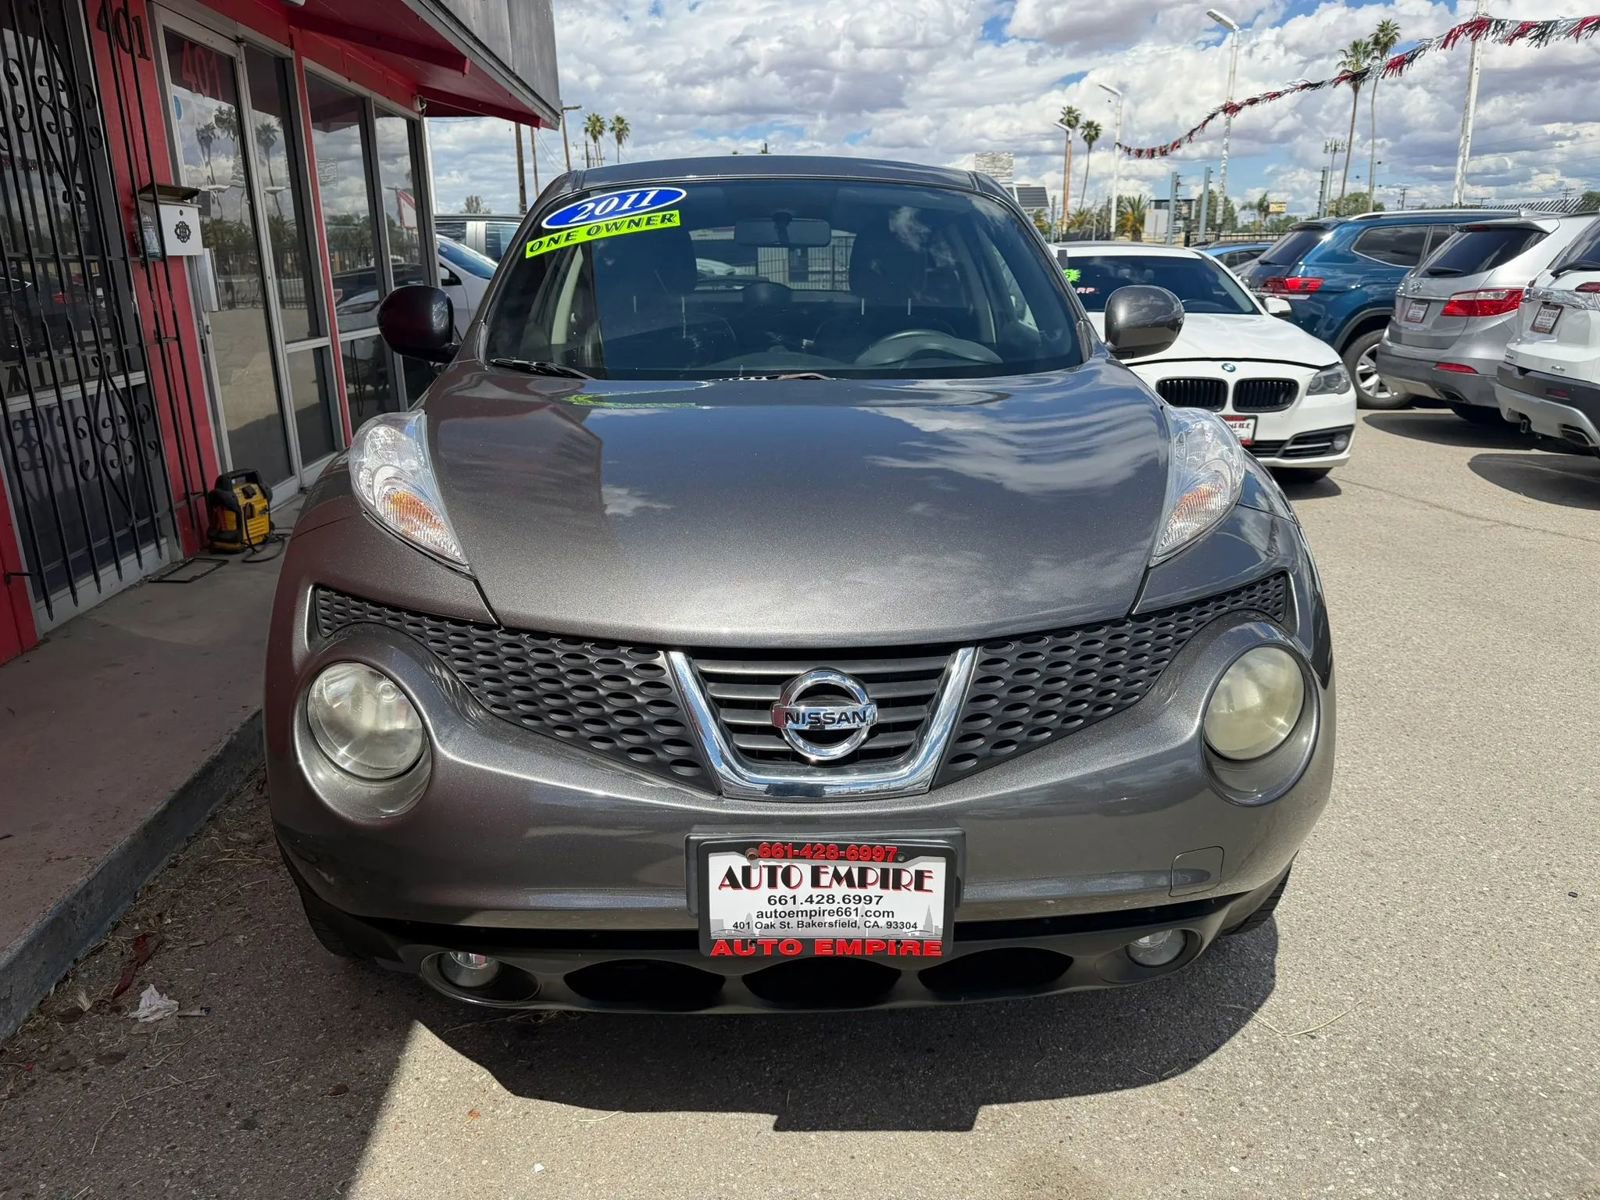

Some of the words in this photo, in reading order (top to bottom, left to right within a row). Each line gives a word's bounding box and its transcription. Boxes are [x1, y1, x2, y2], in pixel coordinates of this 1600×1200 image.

[97, 0, 151, 61] 401
[181, 40, 223, 101] 401
[568, 189, 659, 223] 2011
[528, 230, 578, 253] ONE
[586, 212, 677, 236] OWNER
[784, 709, 867, 725] NISSAN
[758, 841, 898, 863] 661-428-6997
[718, 864, 803, 891] AUTO
[810, 864, 934, 893] EMPIRE
[767, 893, 884, 906] 661.428.6997
[756, 906, 895, 919] autoempire661.com
[732, 921, 751, 930] 401
[754, 920, 776, 930] Oak
[779, 920, 794, 930] St.
[797, 919, 860, 930] Bakersfield,
[863, 920, 883, 930] CA.
[886, 921, 918, 930] 93304
[710, 938, 803, 957] AUTO
[814, 938, 943, 957] EMPIRE
